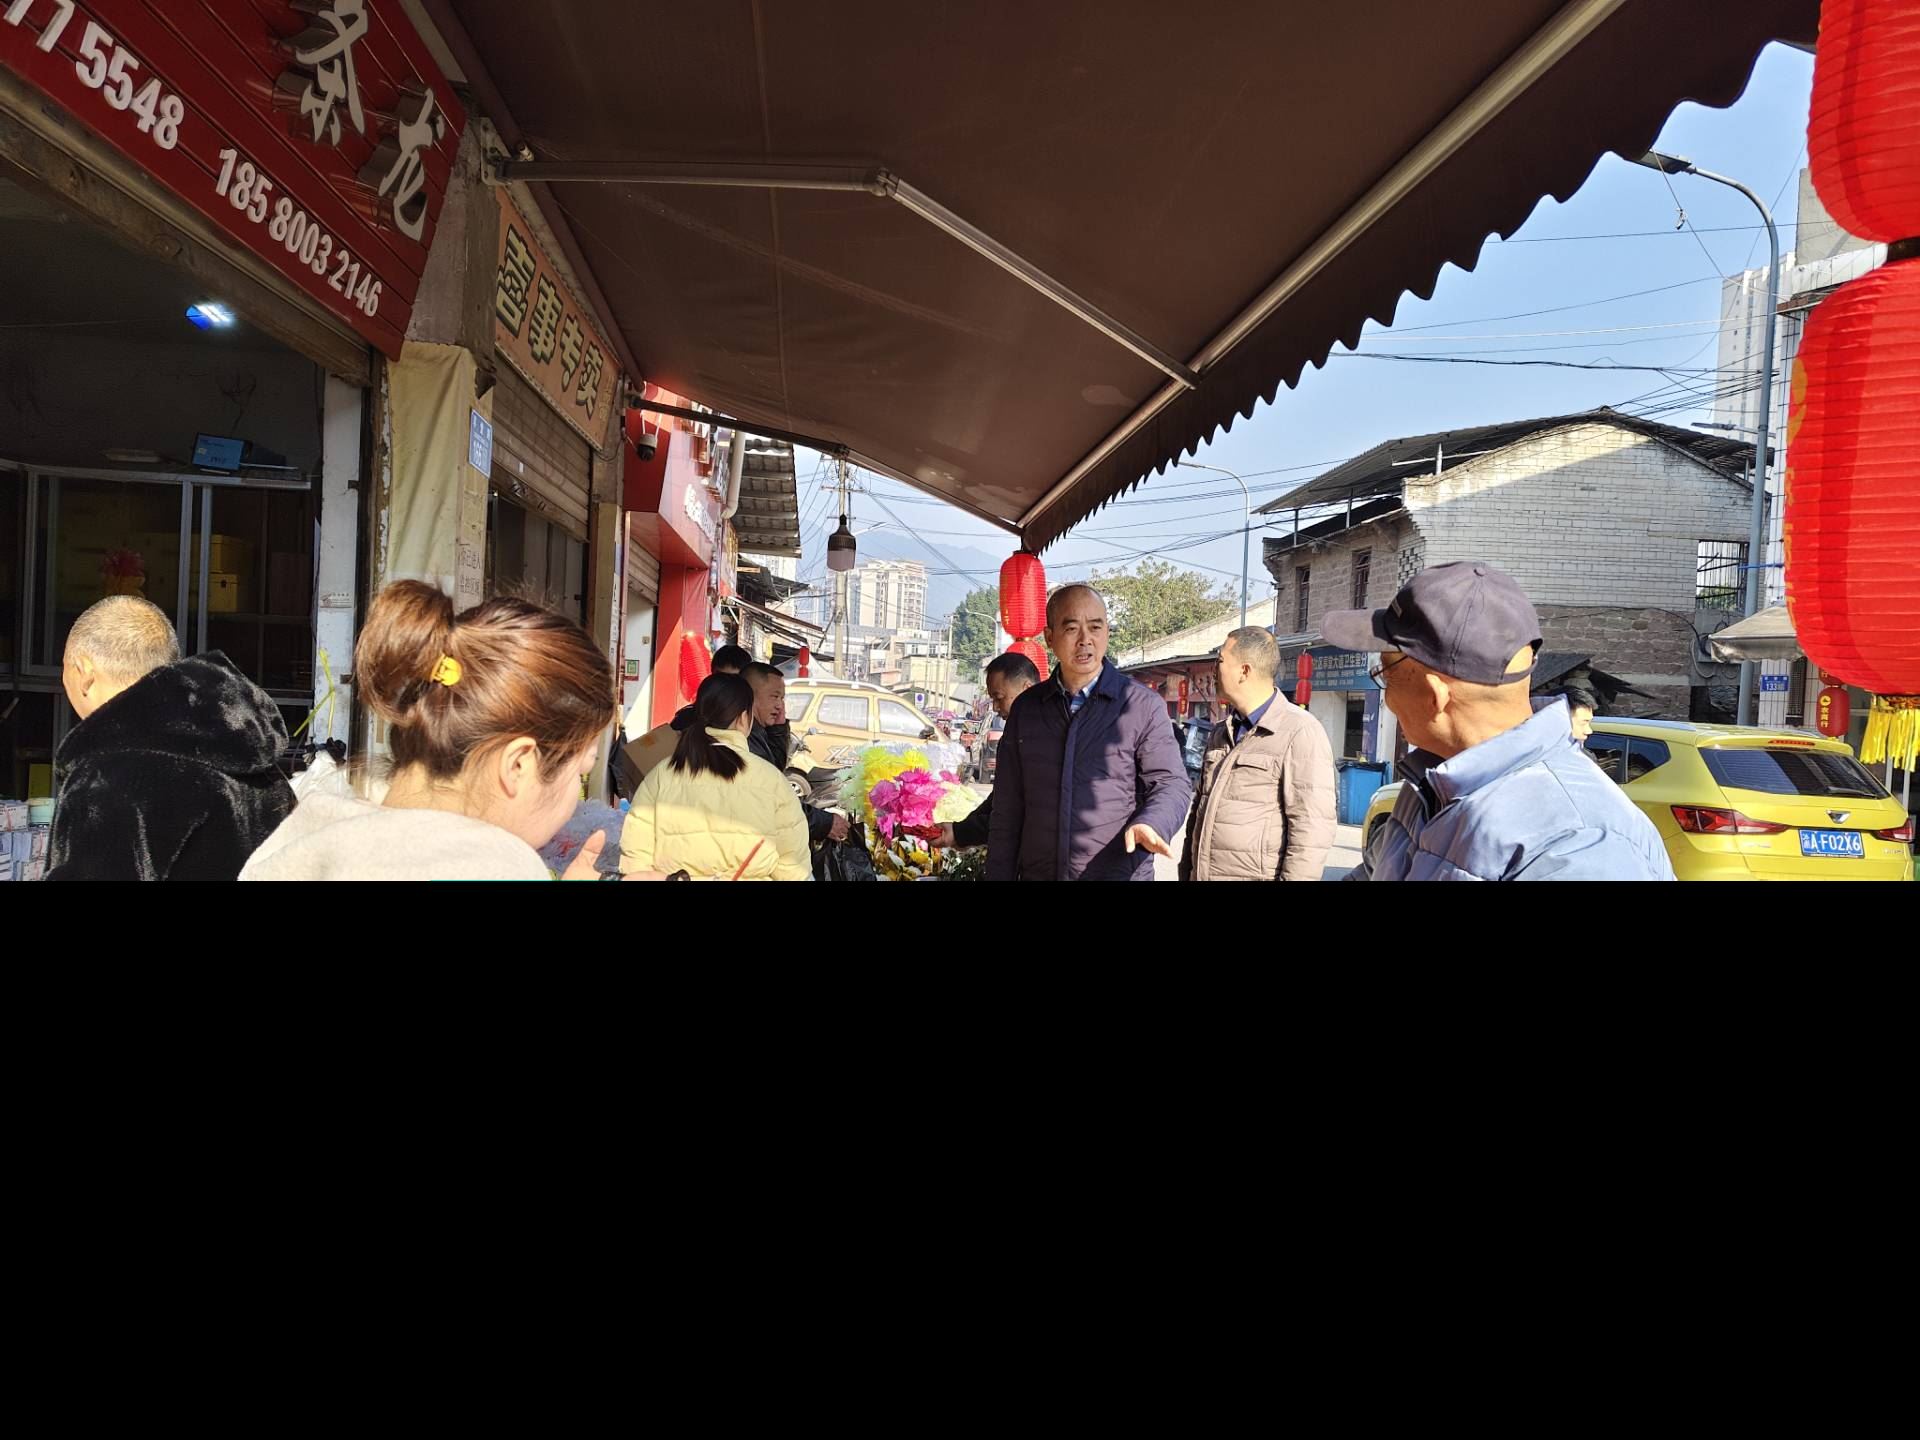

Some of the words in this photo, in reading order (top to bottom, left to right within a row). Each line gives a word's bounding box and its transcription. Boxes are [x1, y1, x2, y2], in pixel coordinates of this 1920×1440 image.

[75, 20, 185, 150] 5548
[215, 148, 273, 224] 185
[268, 197, 333, 275] 8003
[327, 250, 383, 317] 2146
[496, 223, 604, 421] 喜事专卖
